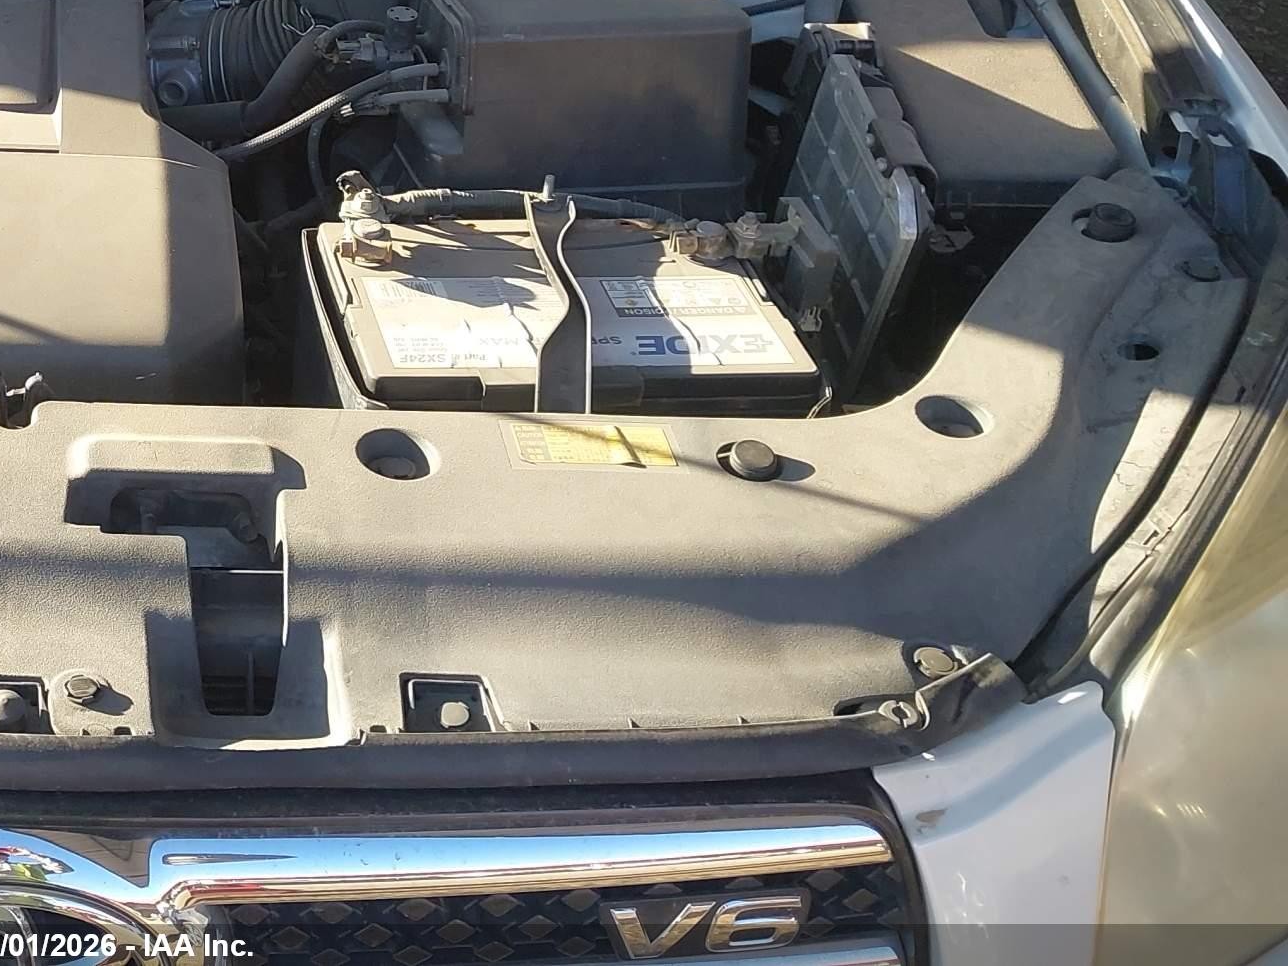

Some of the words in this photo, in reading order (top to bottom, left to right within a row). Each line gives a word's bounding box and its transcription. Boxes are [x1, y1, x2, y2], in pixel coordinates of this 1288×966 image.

[636, 334, 773, 356] EXIDE
[400, 353, 446, 363] SX24F
[609, 895, 802, 960] V6
